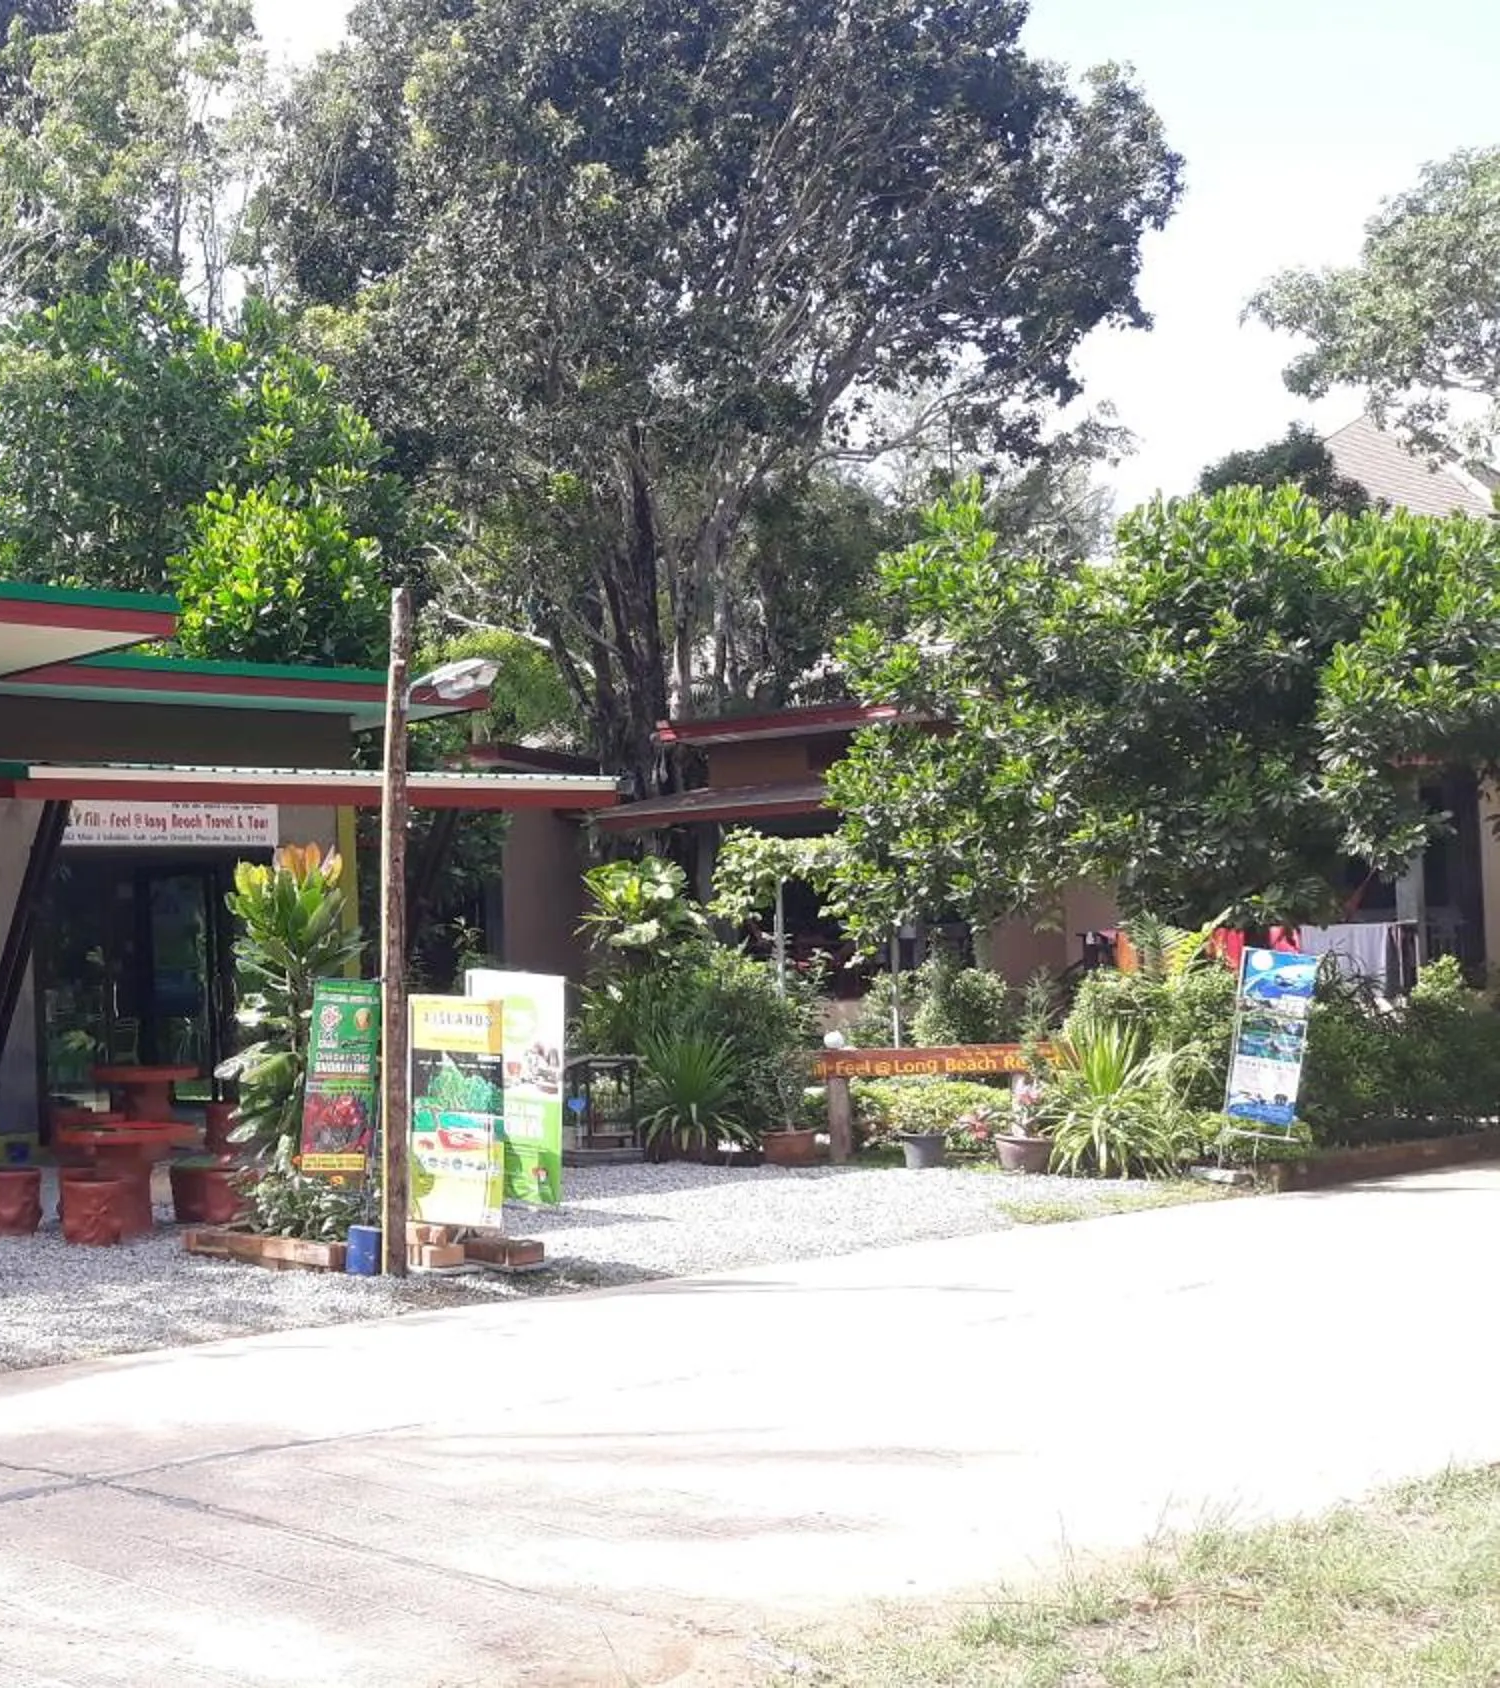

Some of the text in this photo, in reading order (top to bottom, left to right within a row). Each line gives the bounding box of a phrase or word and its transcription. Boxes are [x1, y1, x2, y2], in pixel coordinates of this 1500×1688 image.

[205, 812, 234, 828] Travel
[896, 1058, 938, 1074] Long
[945, 1055, 997, 1071] Beach
